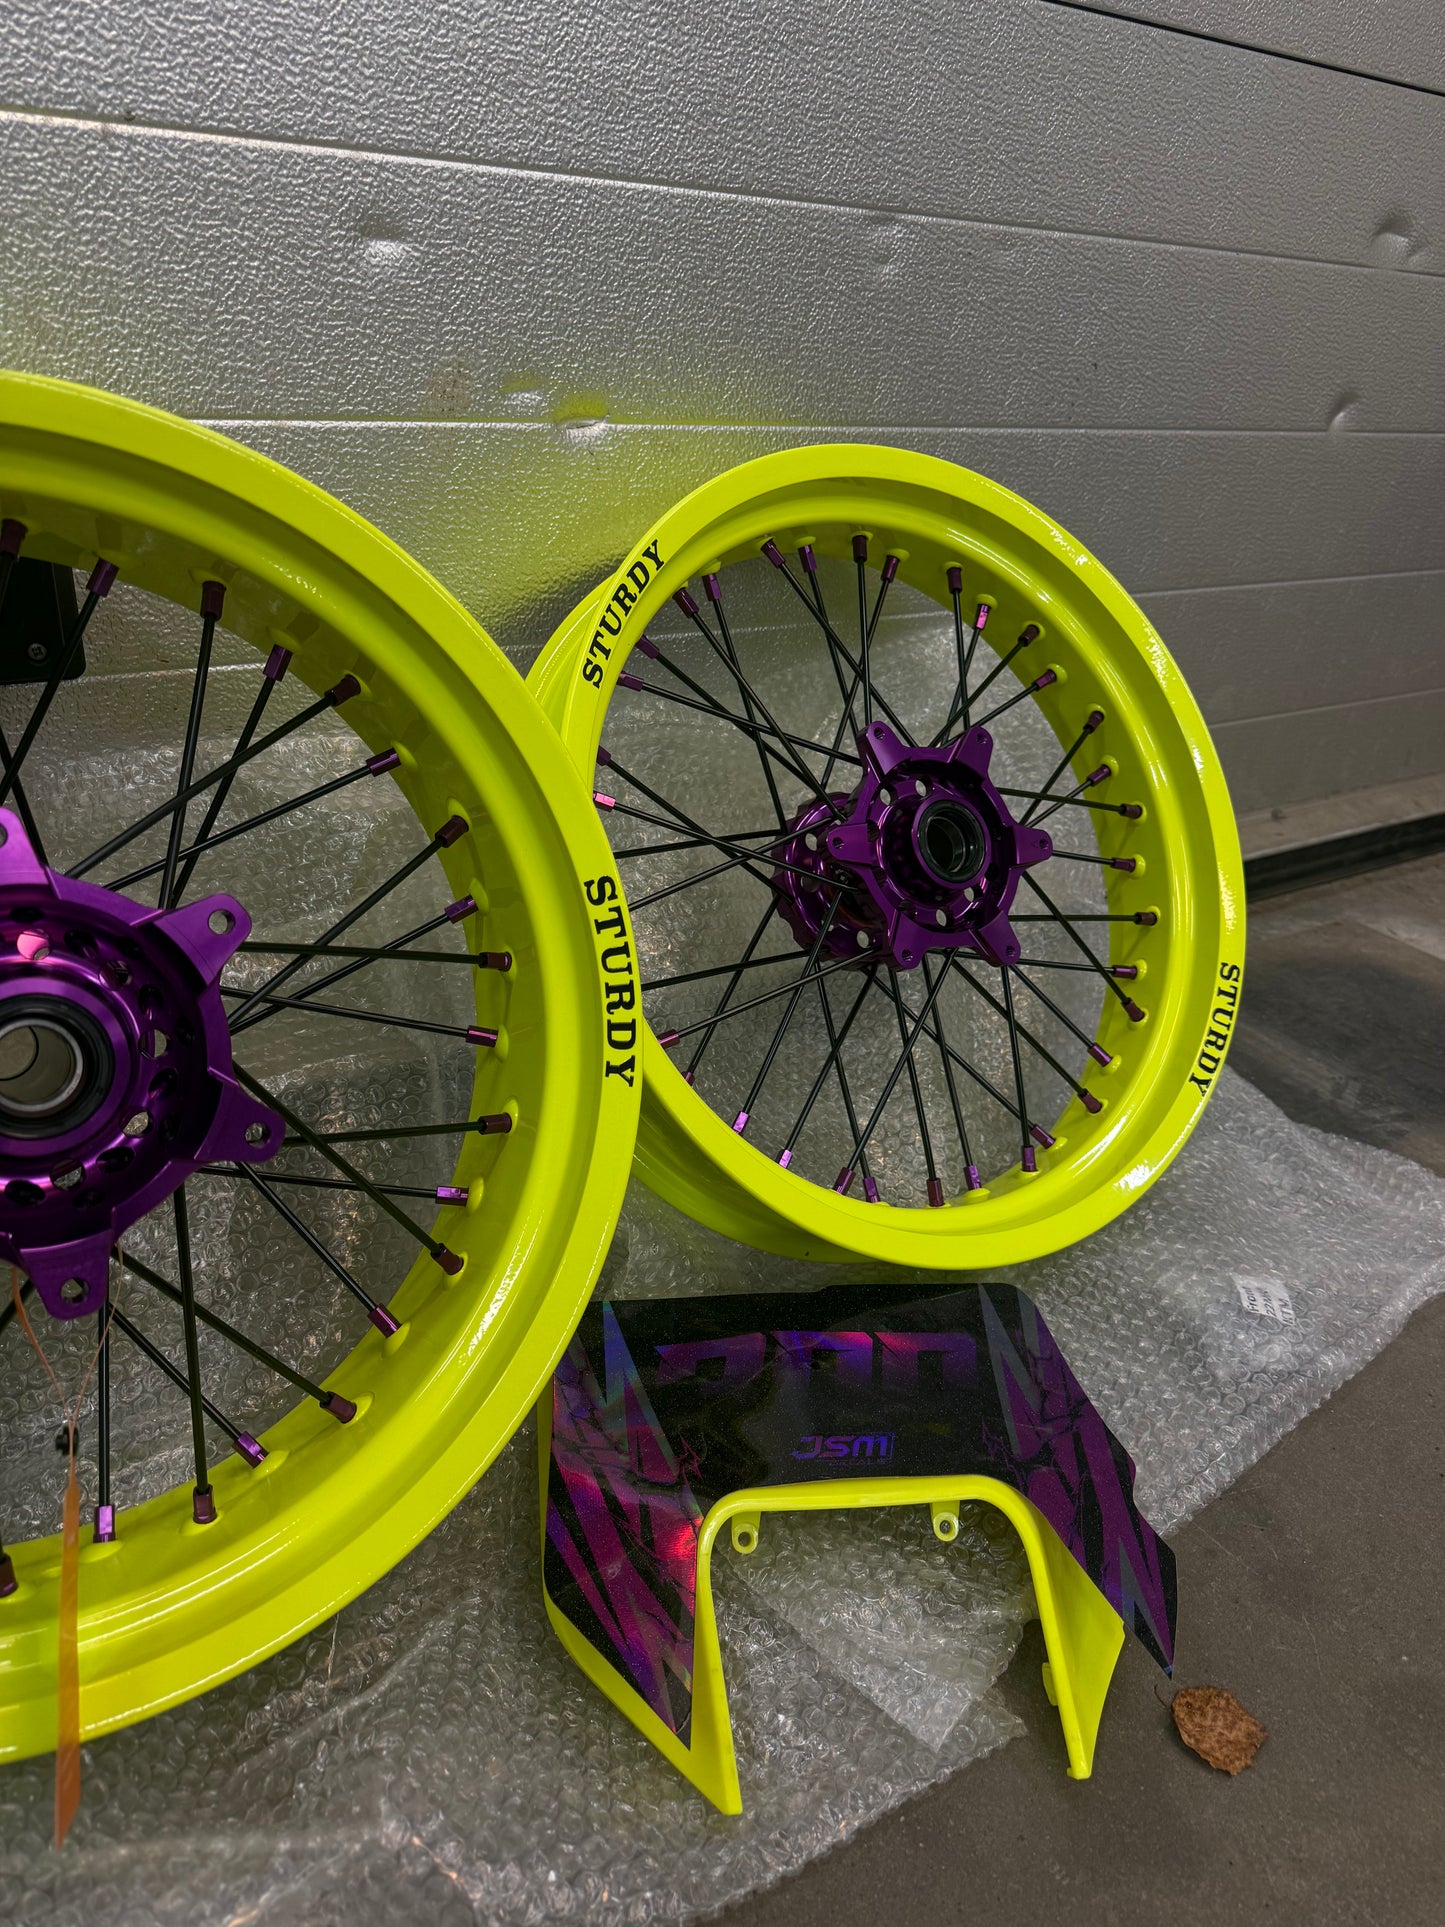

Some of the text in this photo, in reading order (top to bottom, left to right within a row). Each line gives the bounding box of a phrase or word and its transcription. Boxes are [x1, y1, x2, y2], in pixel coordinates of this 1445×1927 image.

[582, 539, 665, 690] STURDY
[584, 875, 637, 1088] STURDY
[1188, 962, 1241, 1096] STURDY
